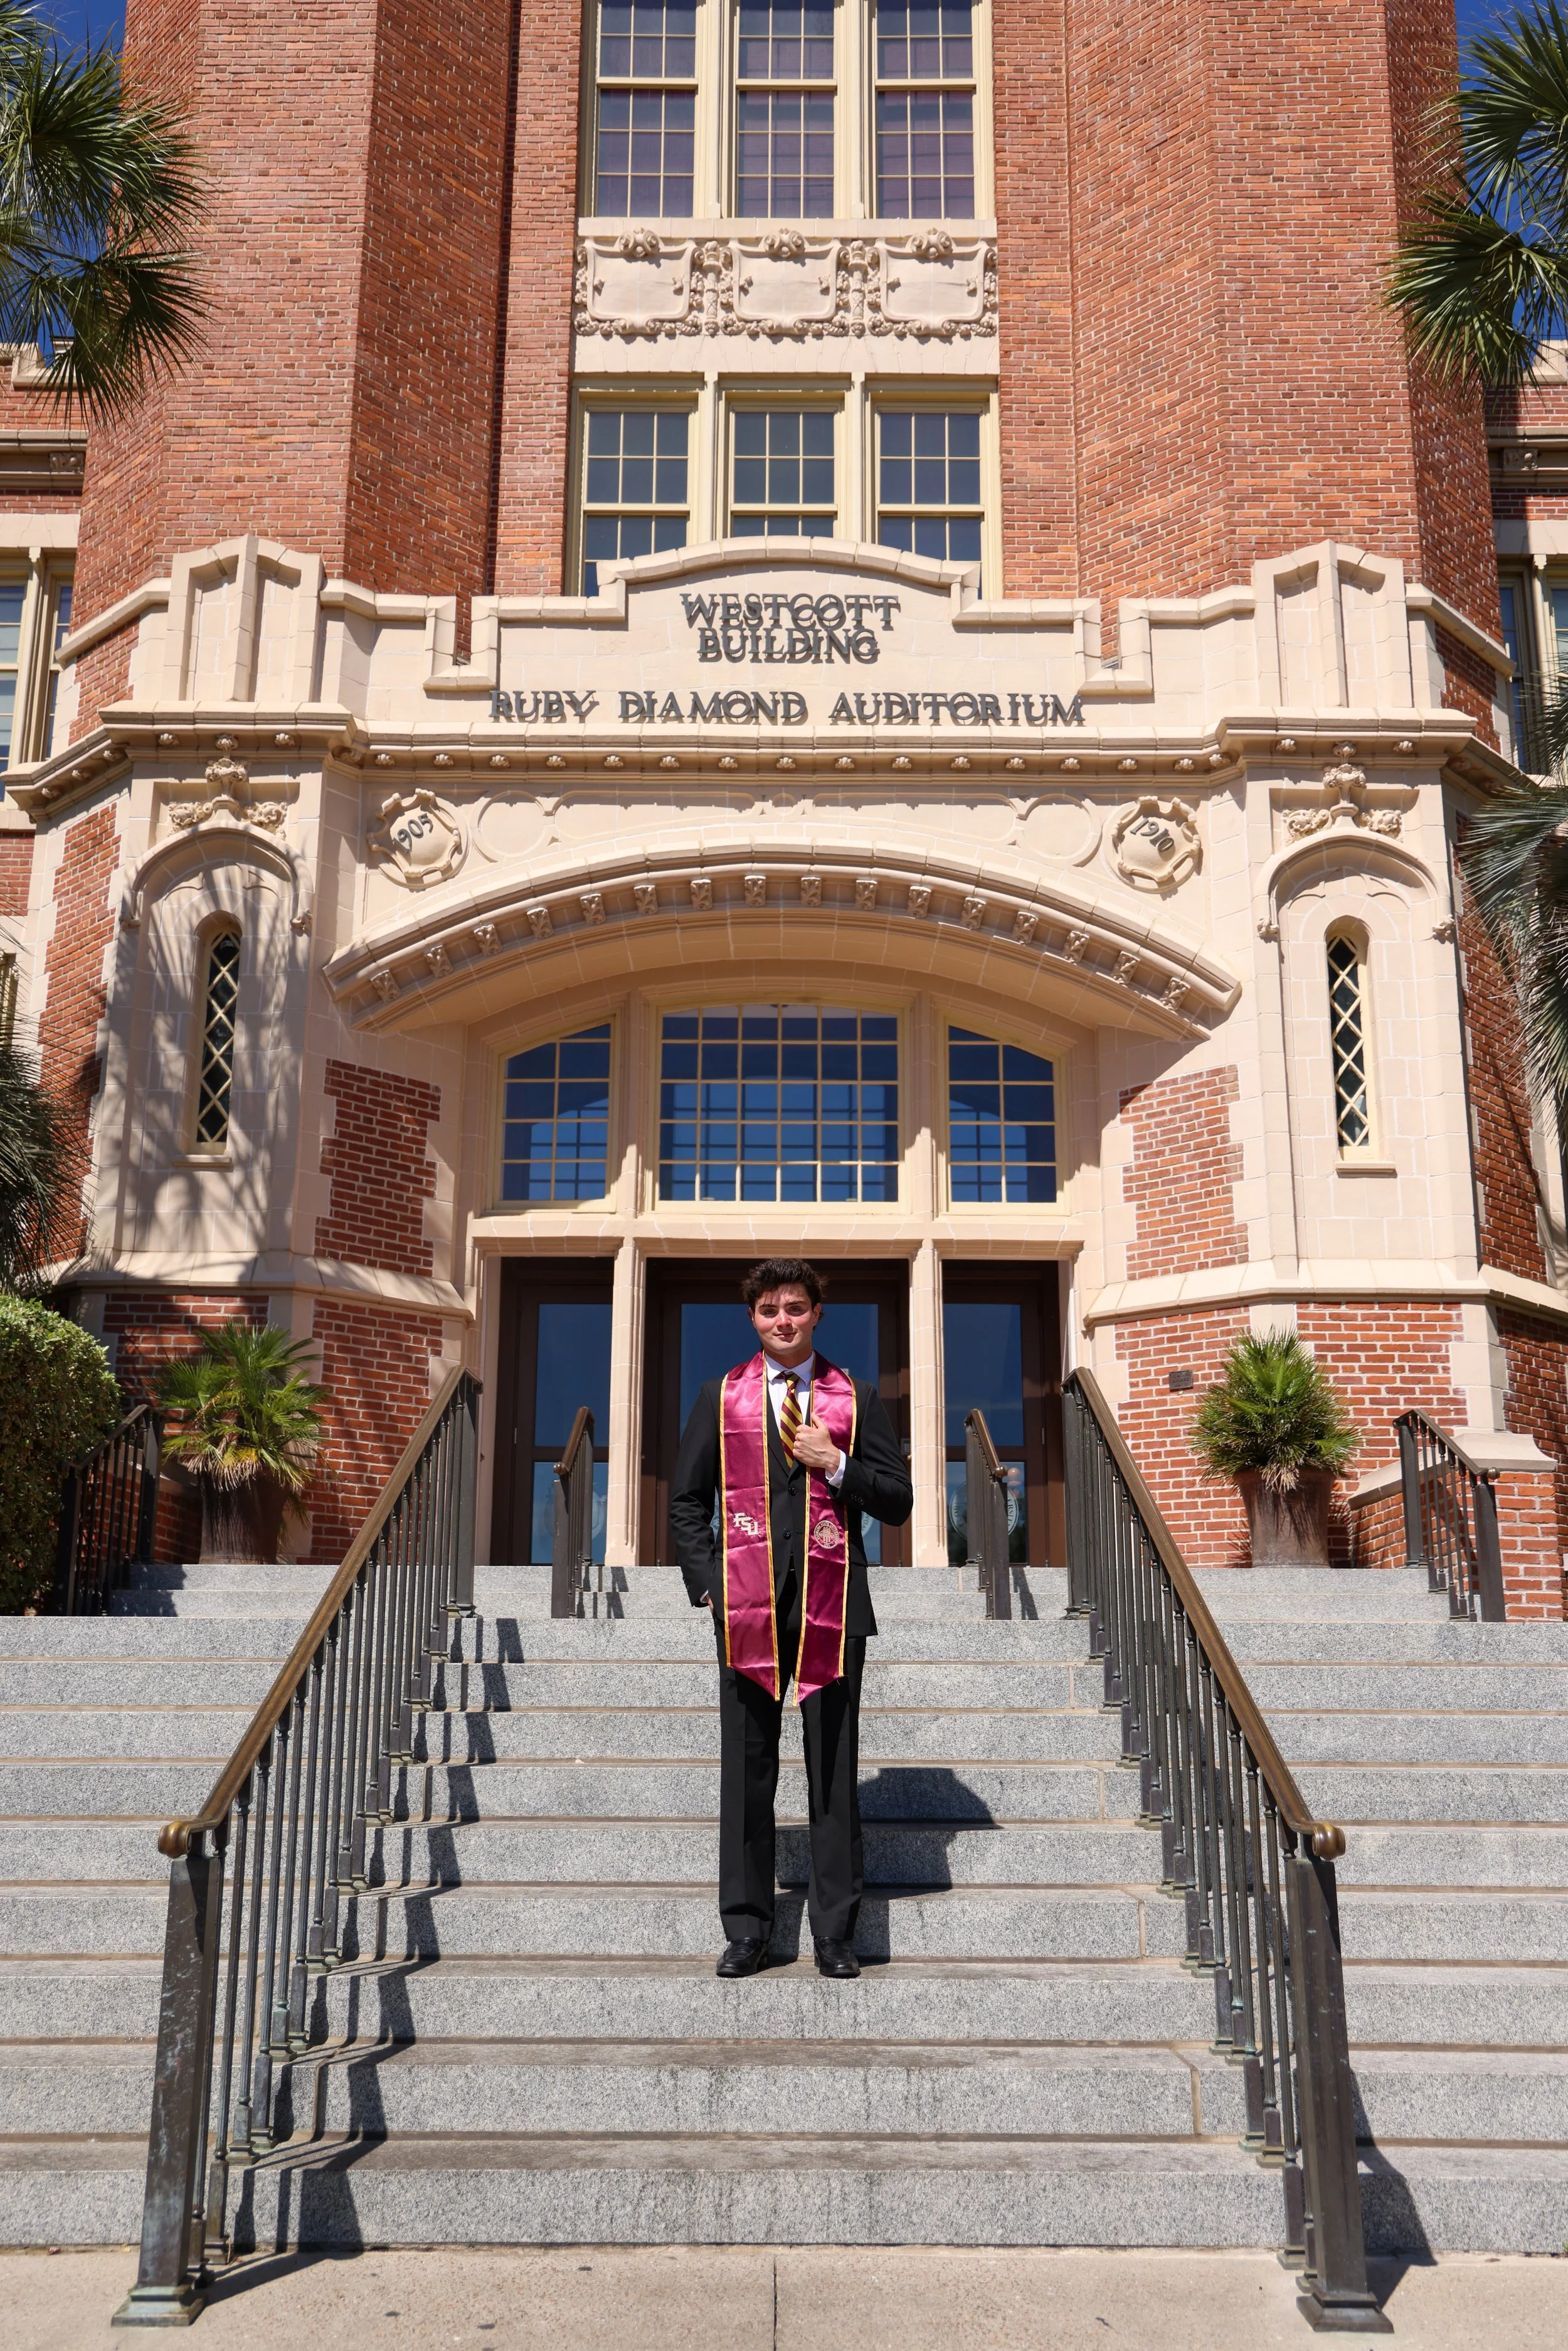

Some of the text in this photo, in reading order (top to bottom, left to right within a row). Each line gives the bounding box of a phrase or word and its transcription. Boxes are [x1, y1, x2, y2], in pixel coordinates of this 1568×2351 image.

[679, 593, 900, 622] WESTCOTT
[697, 627, 879, 657] BUILDING
[488, 690, 1086, 721] RUBY DIAMOND AUDITORIUM
[393, 814, 433, 853] 1905
[1130, 816, 1174, 852] 1910
[733, 1512, 759, 1536] FSU
